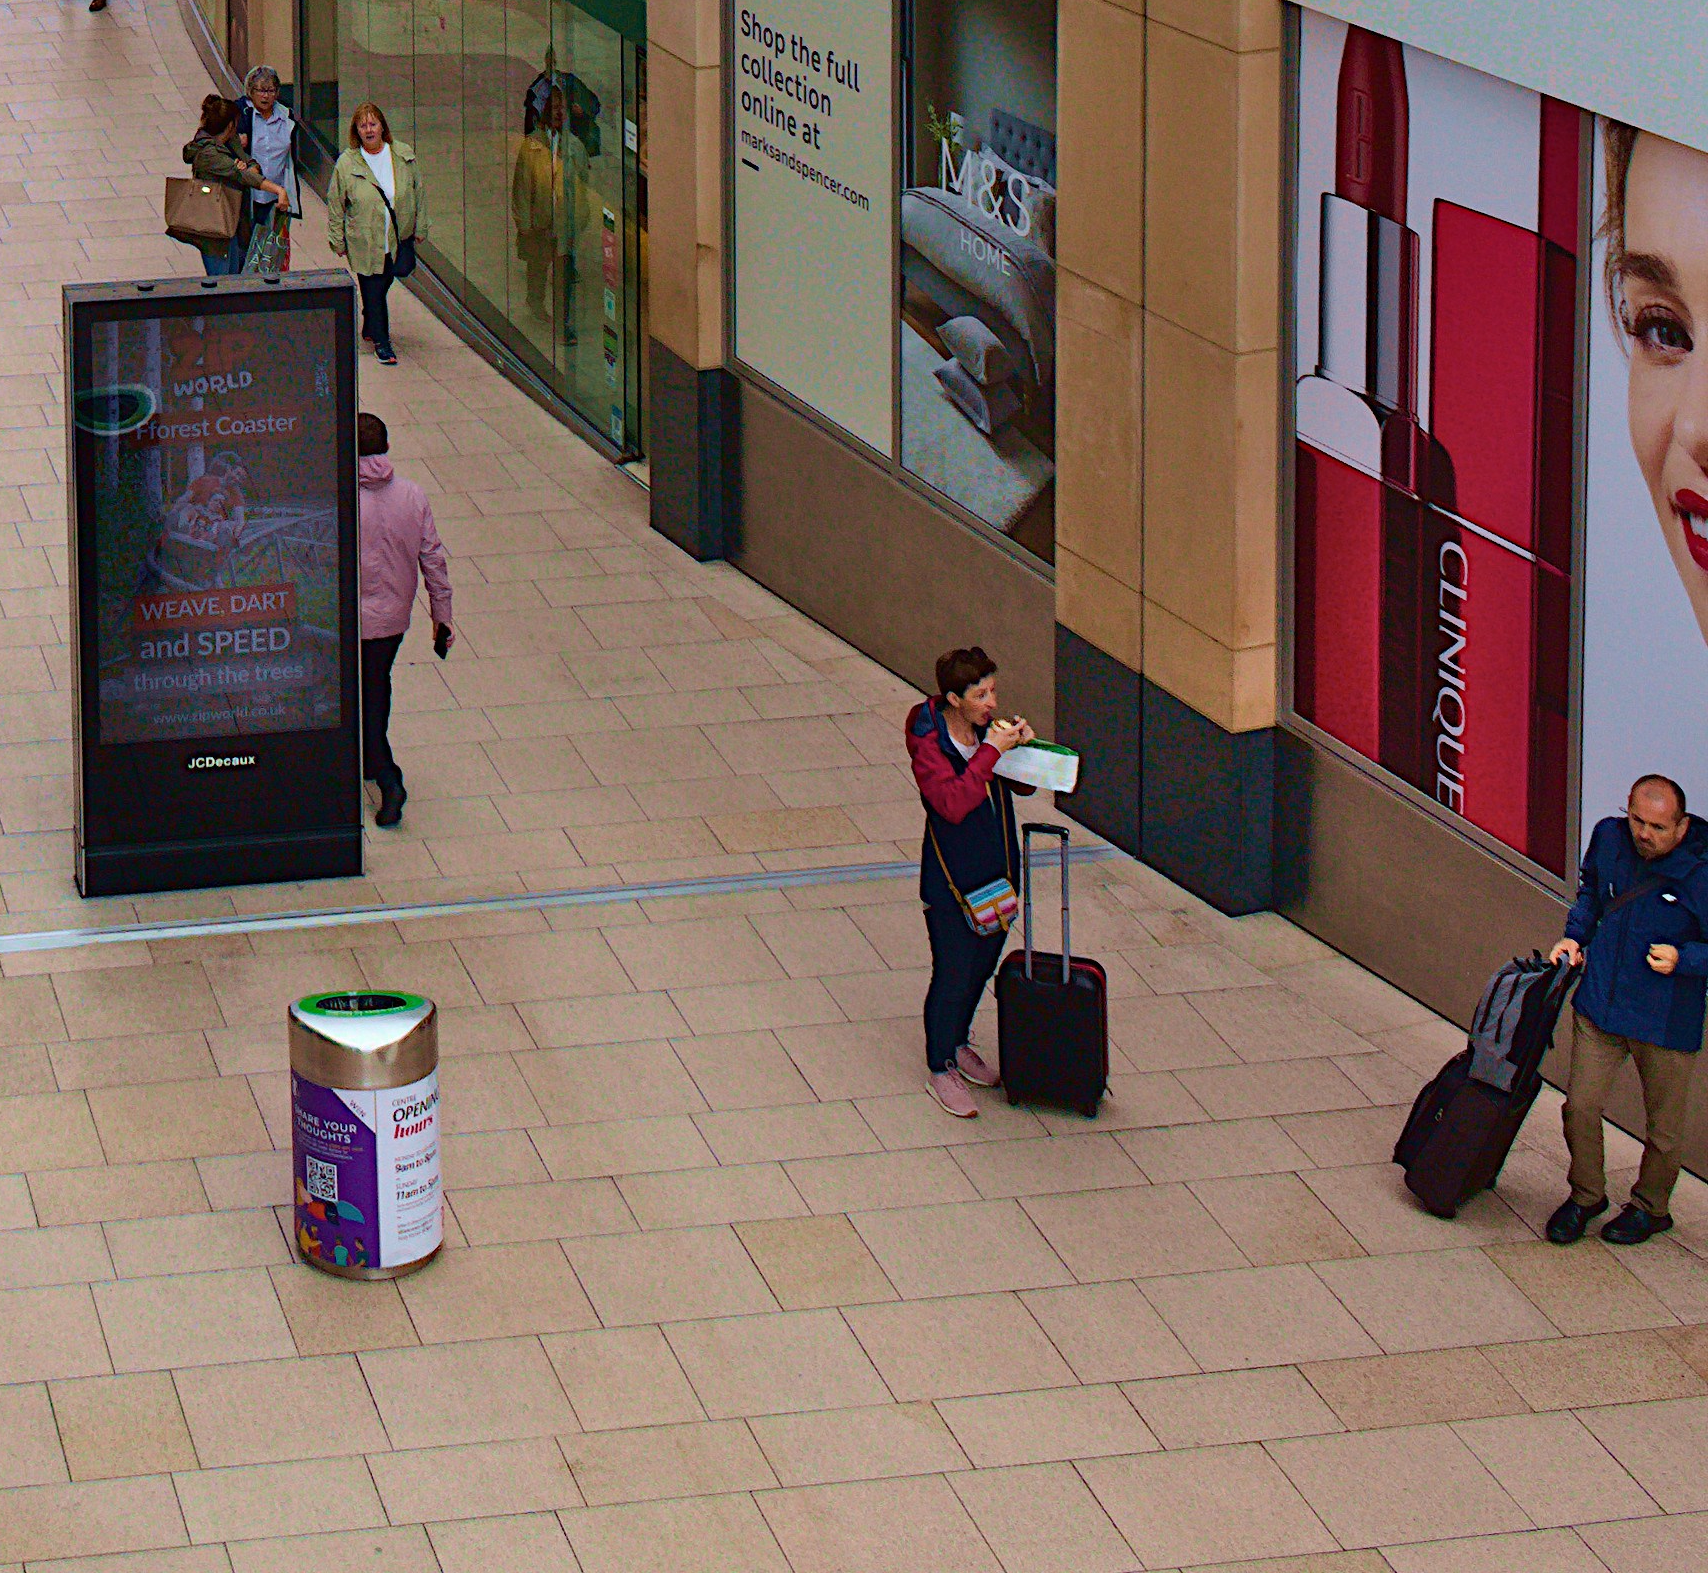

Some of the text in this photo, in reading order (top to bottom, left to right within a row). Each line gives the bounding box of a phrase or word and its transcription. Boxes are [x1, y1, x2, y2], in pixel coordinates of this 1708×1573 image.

[740, 9, 861, 93] Shop the full
[741, 53, 832, 117] collection
[741, 90, 821, 150] online at
[741, 129, 870, 212] marksandspencer.com
[941, 136, 1031, 237] M&S
[960, 228, 1012, 277] HOME
[173, 370, 254, 398] WORLD
[215, 413, 298, 436] Coaster
[230, 590, 290, 614] DART
[140, 626, 291, 659] and SPEED
[133, 664, 305, 692] through the trees
[1432, 540, 1469, 815] CLINIQUE
[187, 755, 256, 770] JCDecaux
[323, 1119, 358, 1135] YOUR
[393, 1114, 434, 1140] hours
